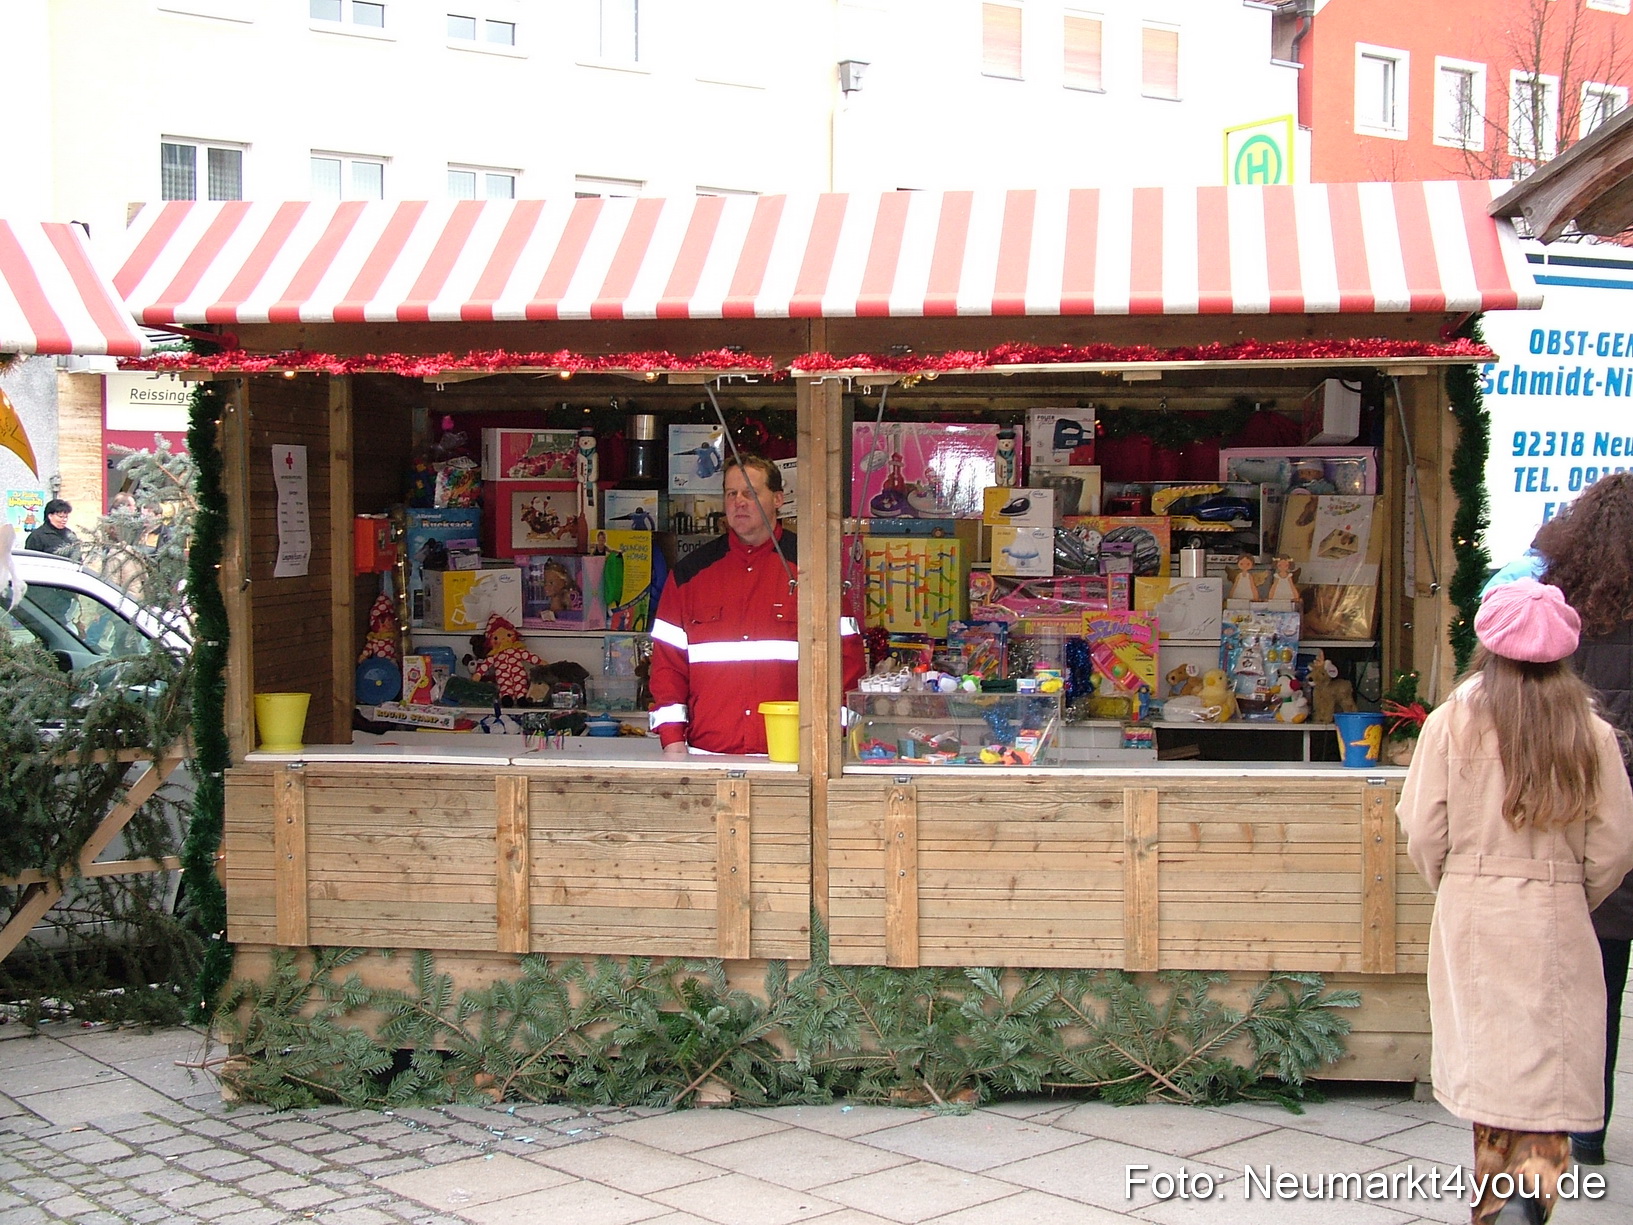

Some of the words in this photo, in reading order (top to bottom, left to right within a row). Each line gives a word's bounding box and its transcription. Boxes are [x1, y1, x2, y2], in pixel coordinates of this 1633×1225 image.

[1247, 149, 1269, 185] H
[1481, 363, 1633, 397] Schmidt-Ni
[1511, 431, 1584, 457] 92318
[1513, 466, 1559, 492] TEL.
